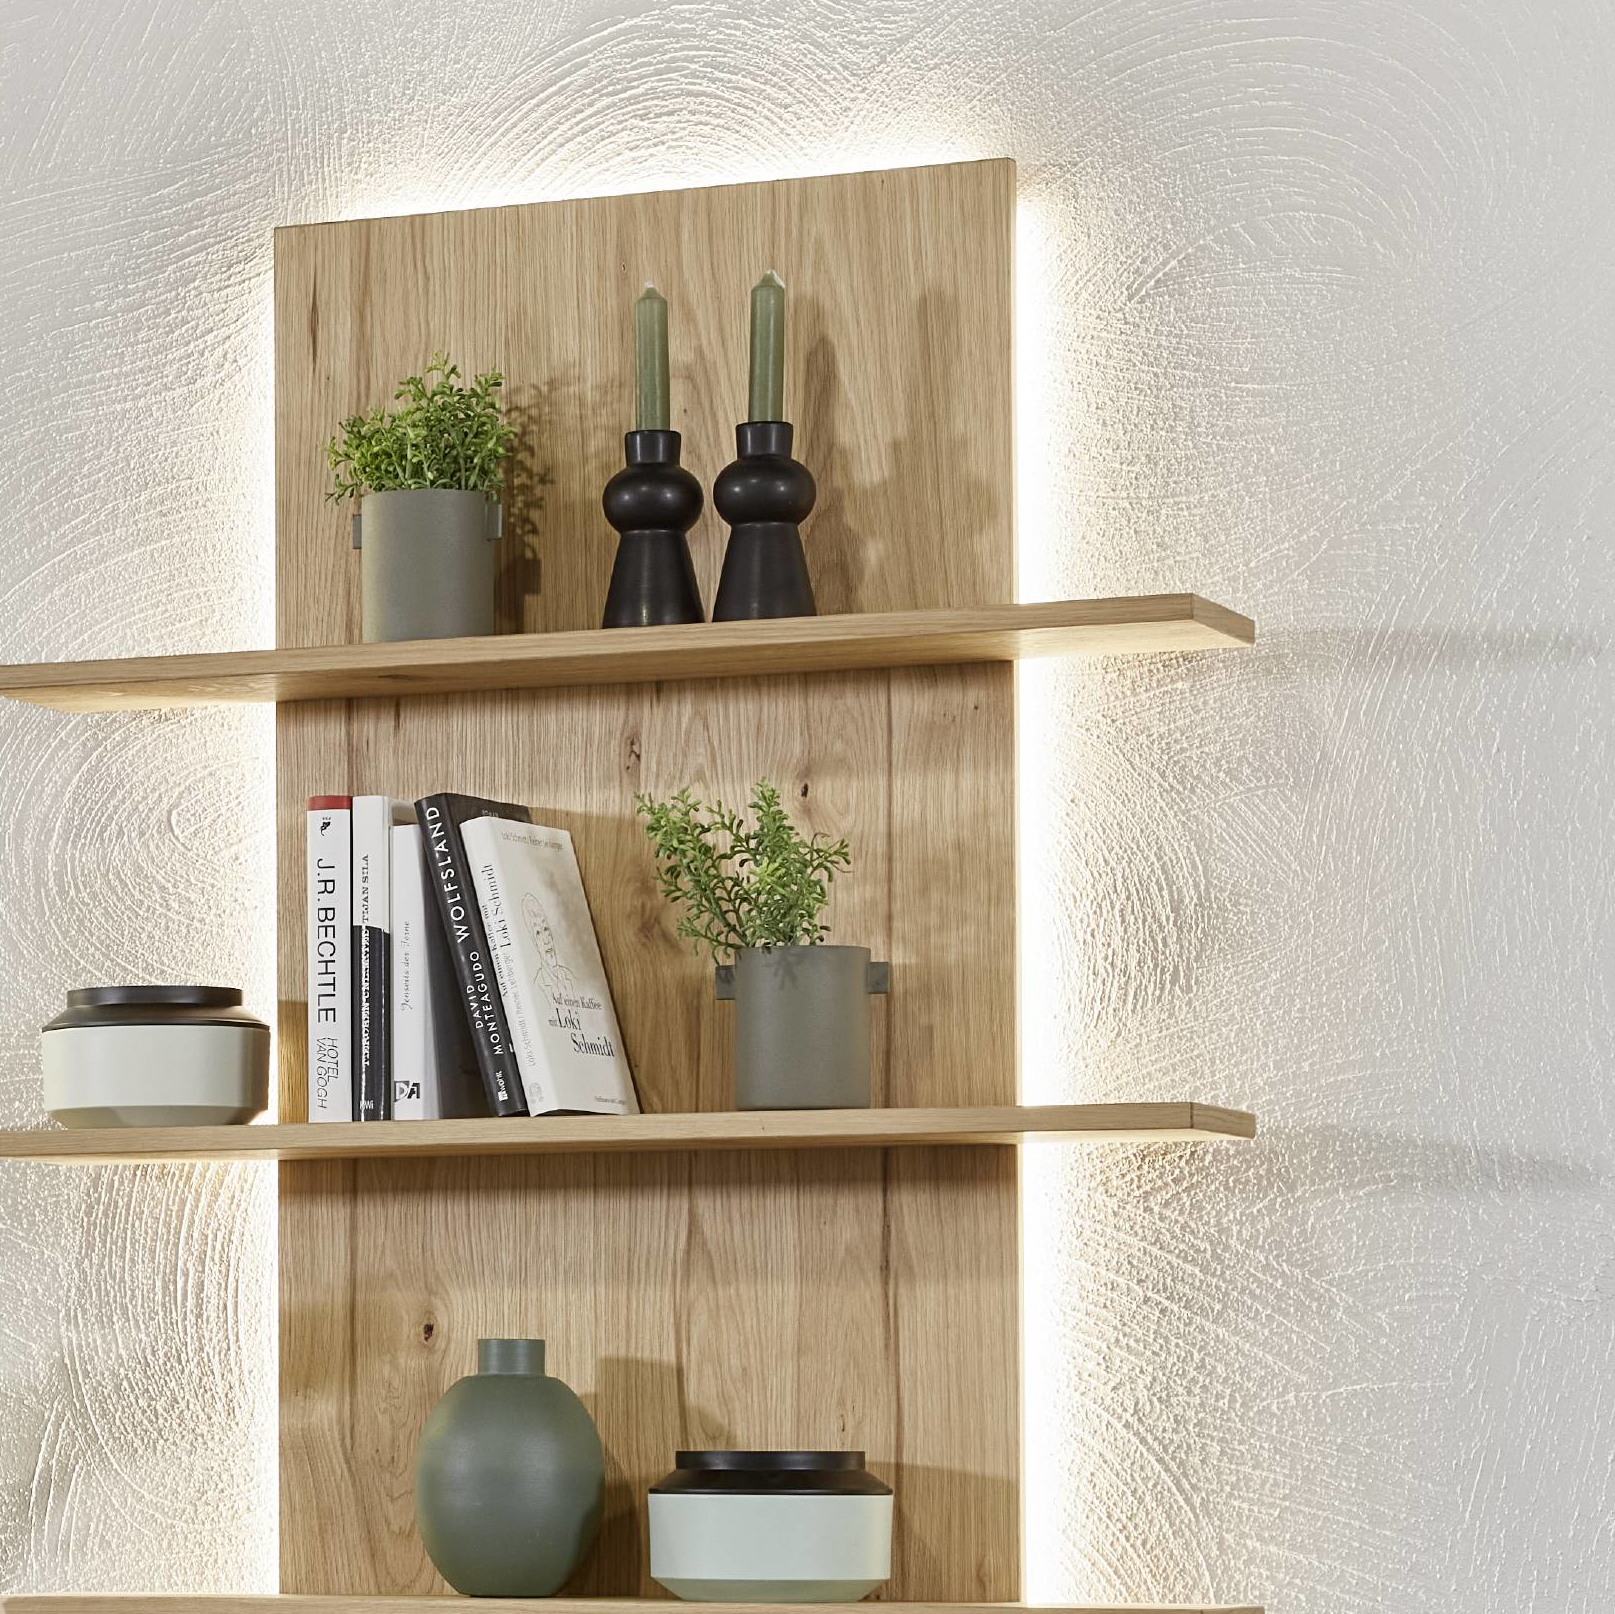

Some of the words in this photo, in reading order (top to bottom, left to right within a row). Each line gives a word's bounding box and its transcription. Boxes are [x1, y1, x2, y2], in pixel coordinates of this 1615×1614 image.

[317, 858, 336, 902] J.R.
[361, 854, 370, 883] SILA
[425, 806, 470, 944] WOLFSLAND
[481, 864, 504, 917] Schmidt
[361, 886, 370, 923] TIJAN
[494, 919, 511, 948] Loki
[317, 908, 336, 1023] BECHTLE
[466, 984, 484, 1030] DAVID
[470, 951, 503, 1056] MONTEAGUDO
[555, 1007, 582, 1031] Loki
[316, 1038, 328, 1063] VAN
[327, 1037, 339, 1083] HOTEL
[571, 1032, 615, 1057] Schmidt
[316, 1064, 328, 1109] GOGH
